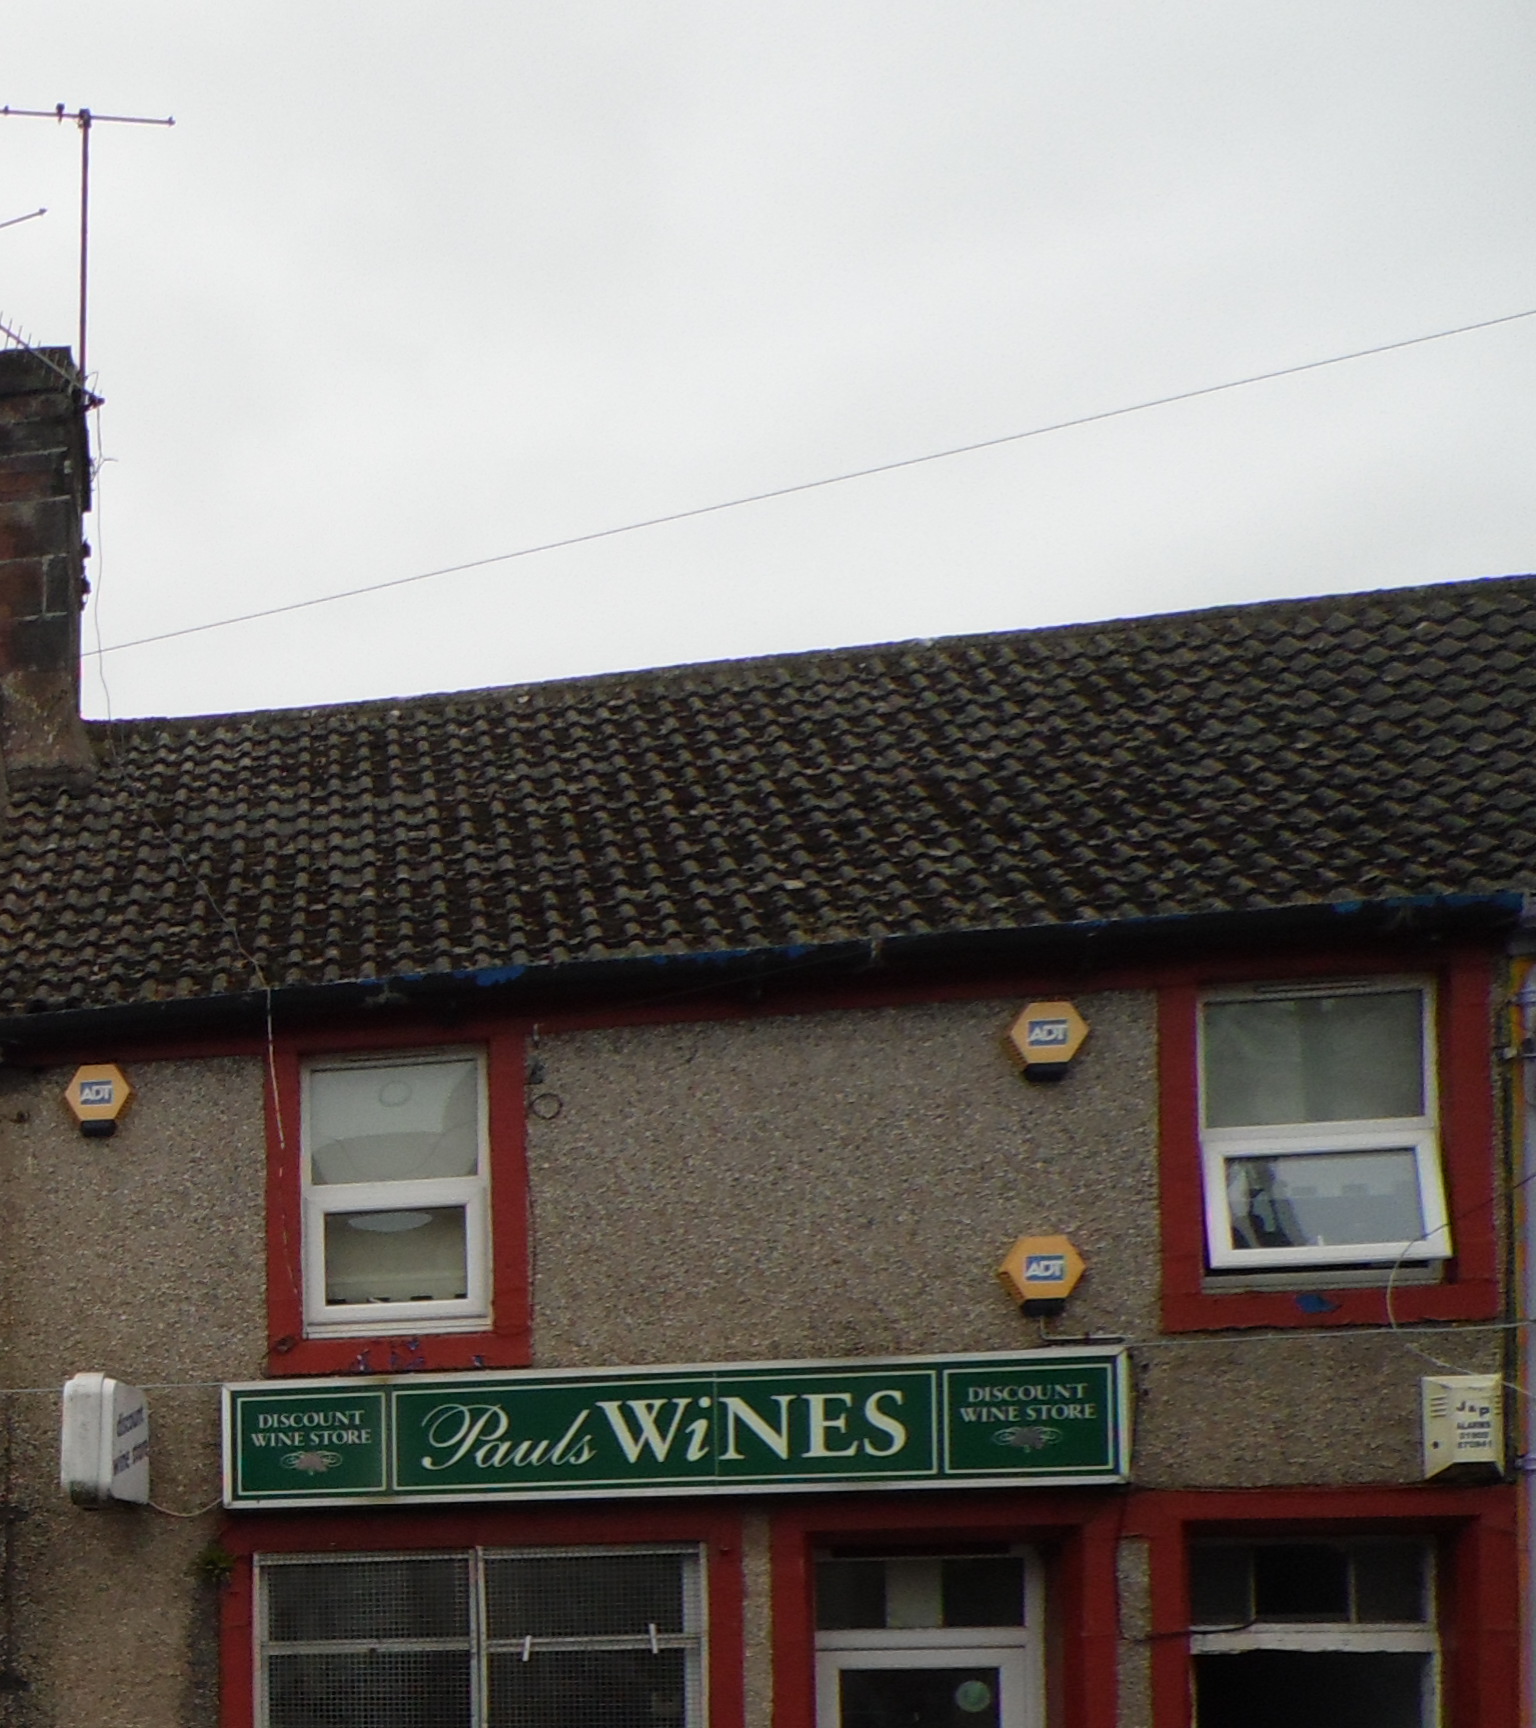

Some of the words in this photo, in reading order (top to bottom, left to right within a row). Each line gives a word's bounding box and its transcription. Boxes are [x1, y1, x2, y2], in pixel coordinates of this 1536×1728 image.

[1027, 1024, 1069, 1042] ADT
[80, 1084, 113, 1101] ADT
[1024, 1259, 1065, 1278] ADT
[967, 1383, 1088, 1403] DISCOUNT
[257, 1410, 366, 1429] DISCOUNT
[959, 1405, 1020, 1424] WINE
[1026, 1403, 1097, 1421] STORE
[250, 1430, 306, 1448] WINE
[309, 1428, 372, 1446] STORE
[420, 1403, 598, 1471] Pauls
